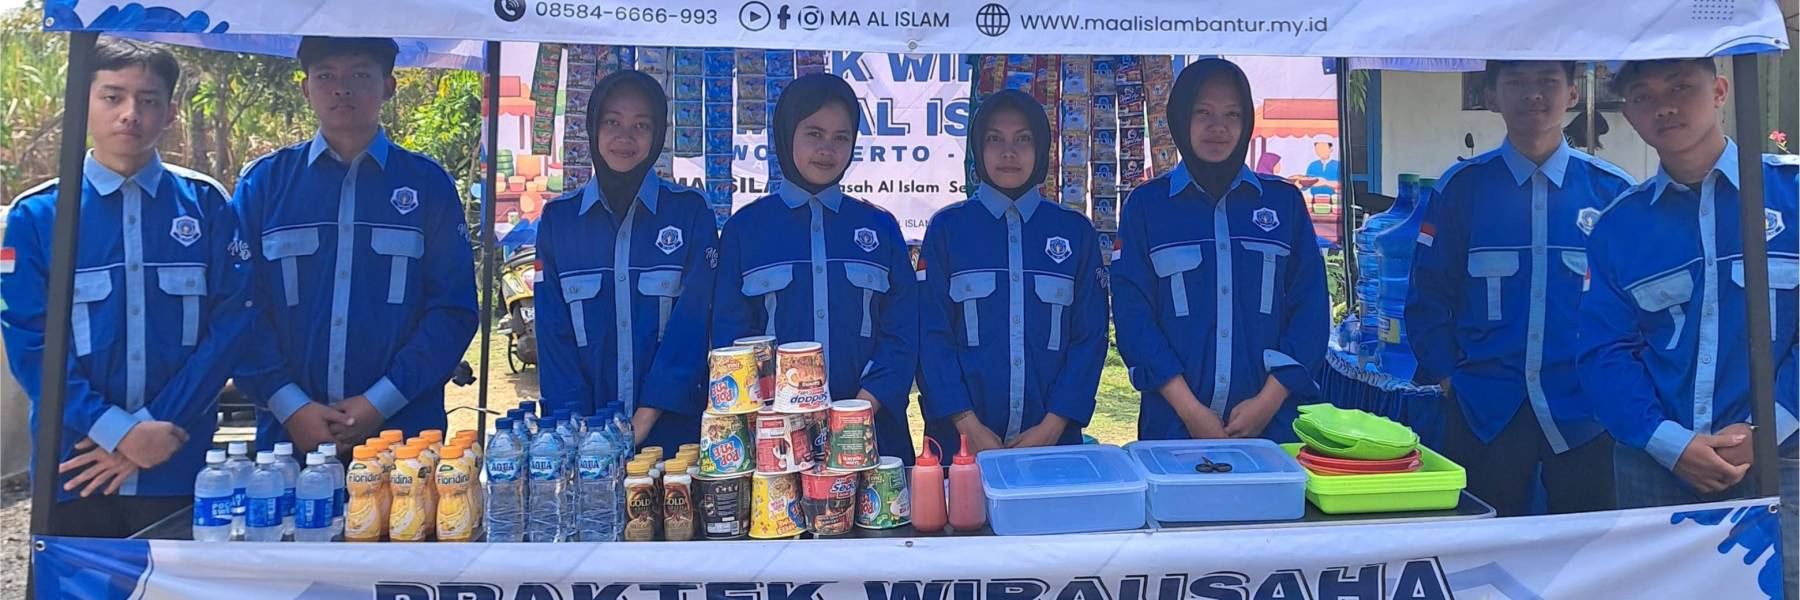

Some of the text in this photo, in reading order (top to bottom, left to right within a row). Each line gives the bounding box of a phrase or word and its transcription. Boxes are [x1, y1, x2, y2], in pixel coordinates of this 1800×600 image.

[535, 1, 718, 25] 08584-6666-993
[830, 10, 950, 28] MA AL ISLAM
[878, 180, 894, 193] Al
[899, 180, 939, 193] Islam
[491, 462, 514, 472] AQUA
